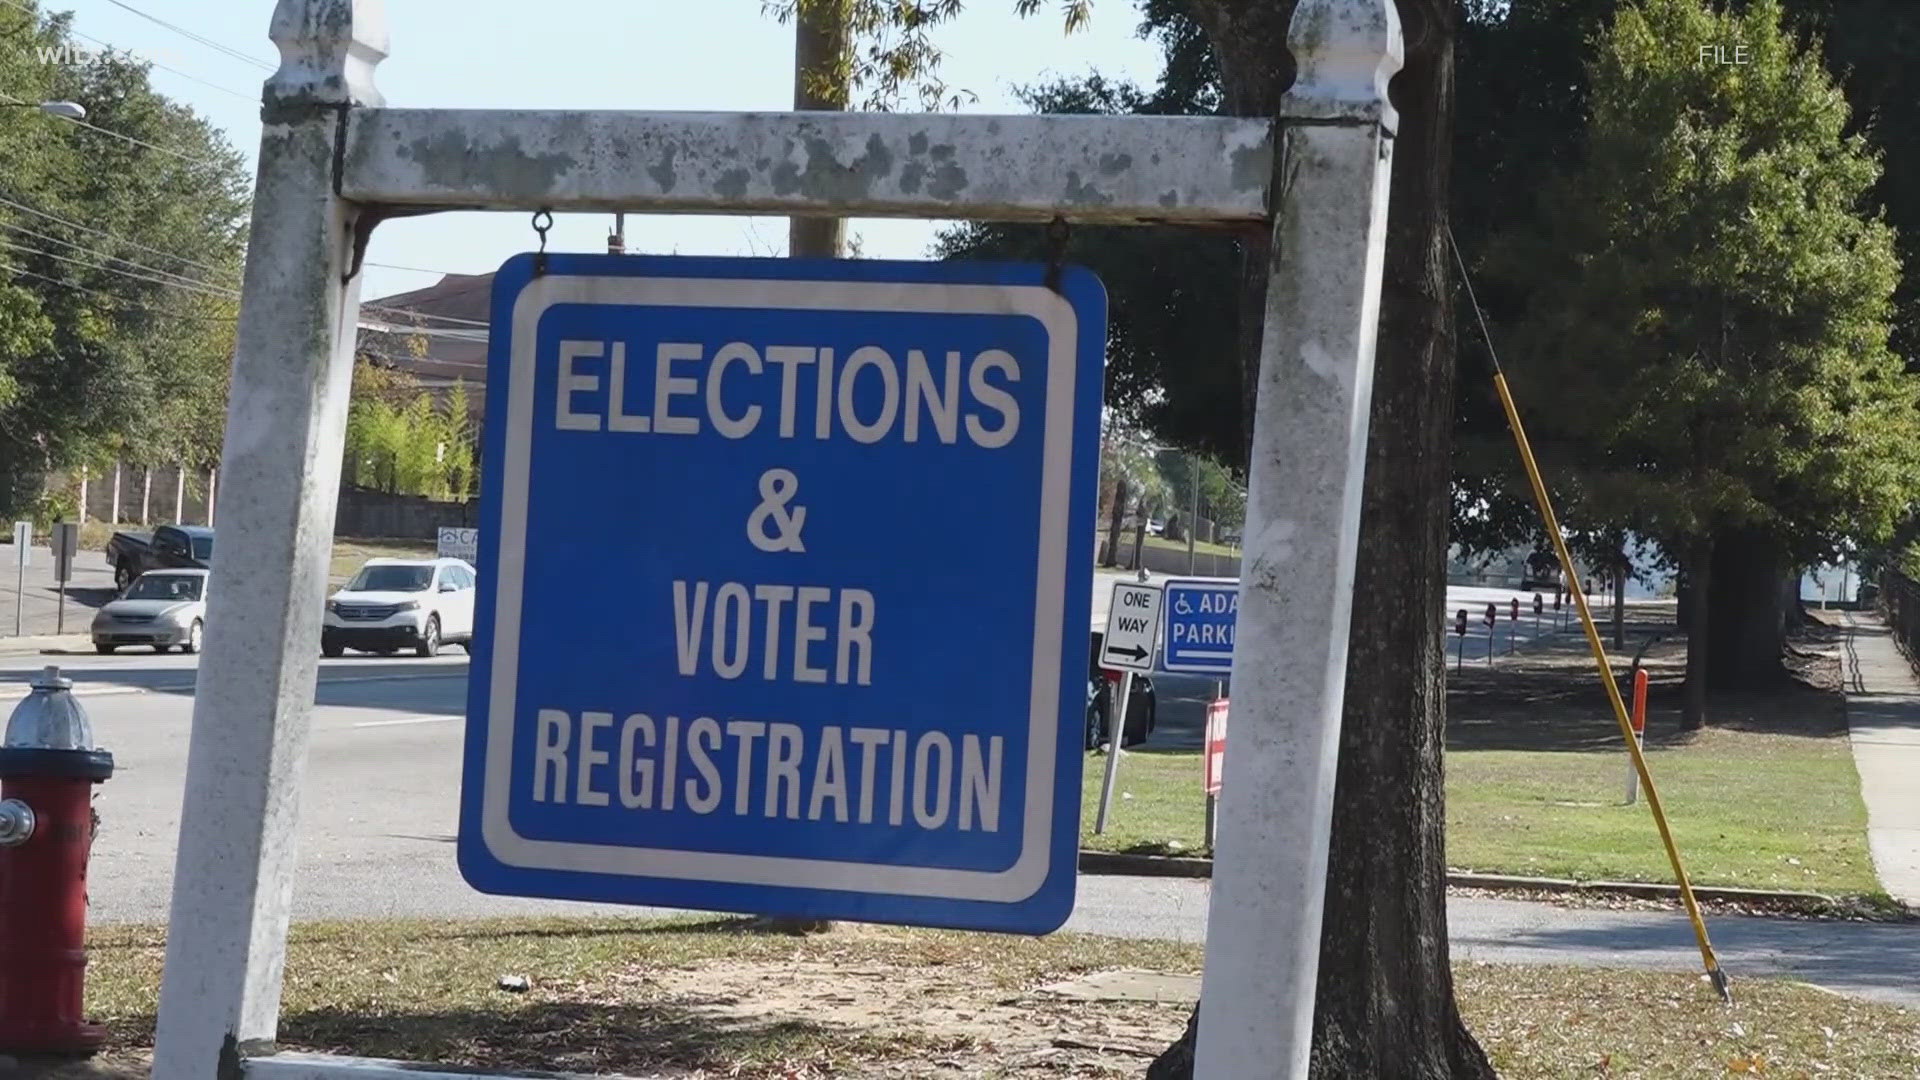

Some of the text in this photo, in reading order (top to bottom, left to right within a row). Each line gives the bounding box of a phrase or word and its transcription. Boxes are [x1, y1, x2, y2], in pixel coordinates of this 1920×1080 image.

[555, 340, 1021, 449] ELECTIONS
[747, 468, 806, 553] &
[673, 581, 876, 686] VOTER
[1118, 617, 1149, 633] WAY
[1123, 591, 1151, 608] ONE
[532, 709, 1004, 833] REGISTRATION
